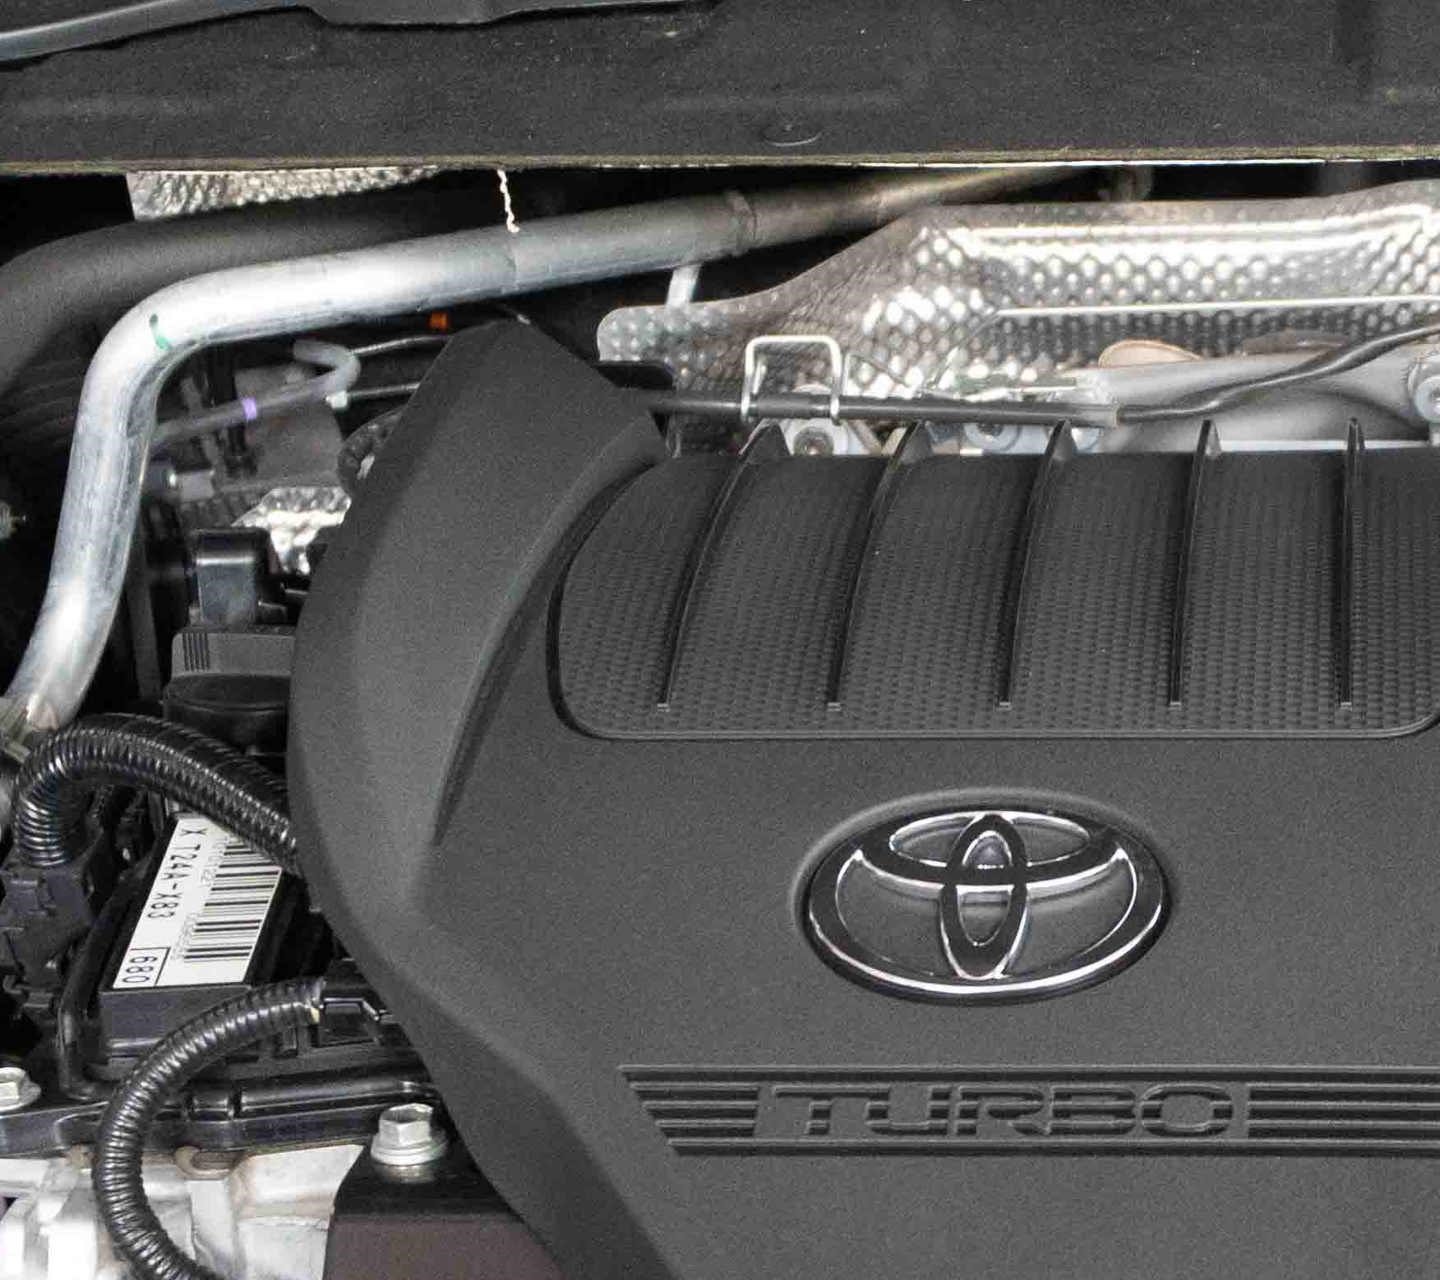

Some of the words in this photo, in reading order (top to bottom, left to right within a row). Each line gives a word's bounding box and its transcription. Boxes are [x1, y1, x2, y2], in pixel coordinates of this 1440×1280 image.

[179, 828, 207, 836] X
[145, 844, 200, 919] T24A-X83
[120, 955, 158, 984] 680
[772, 1082, 1233, 1136] TURBO
